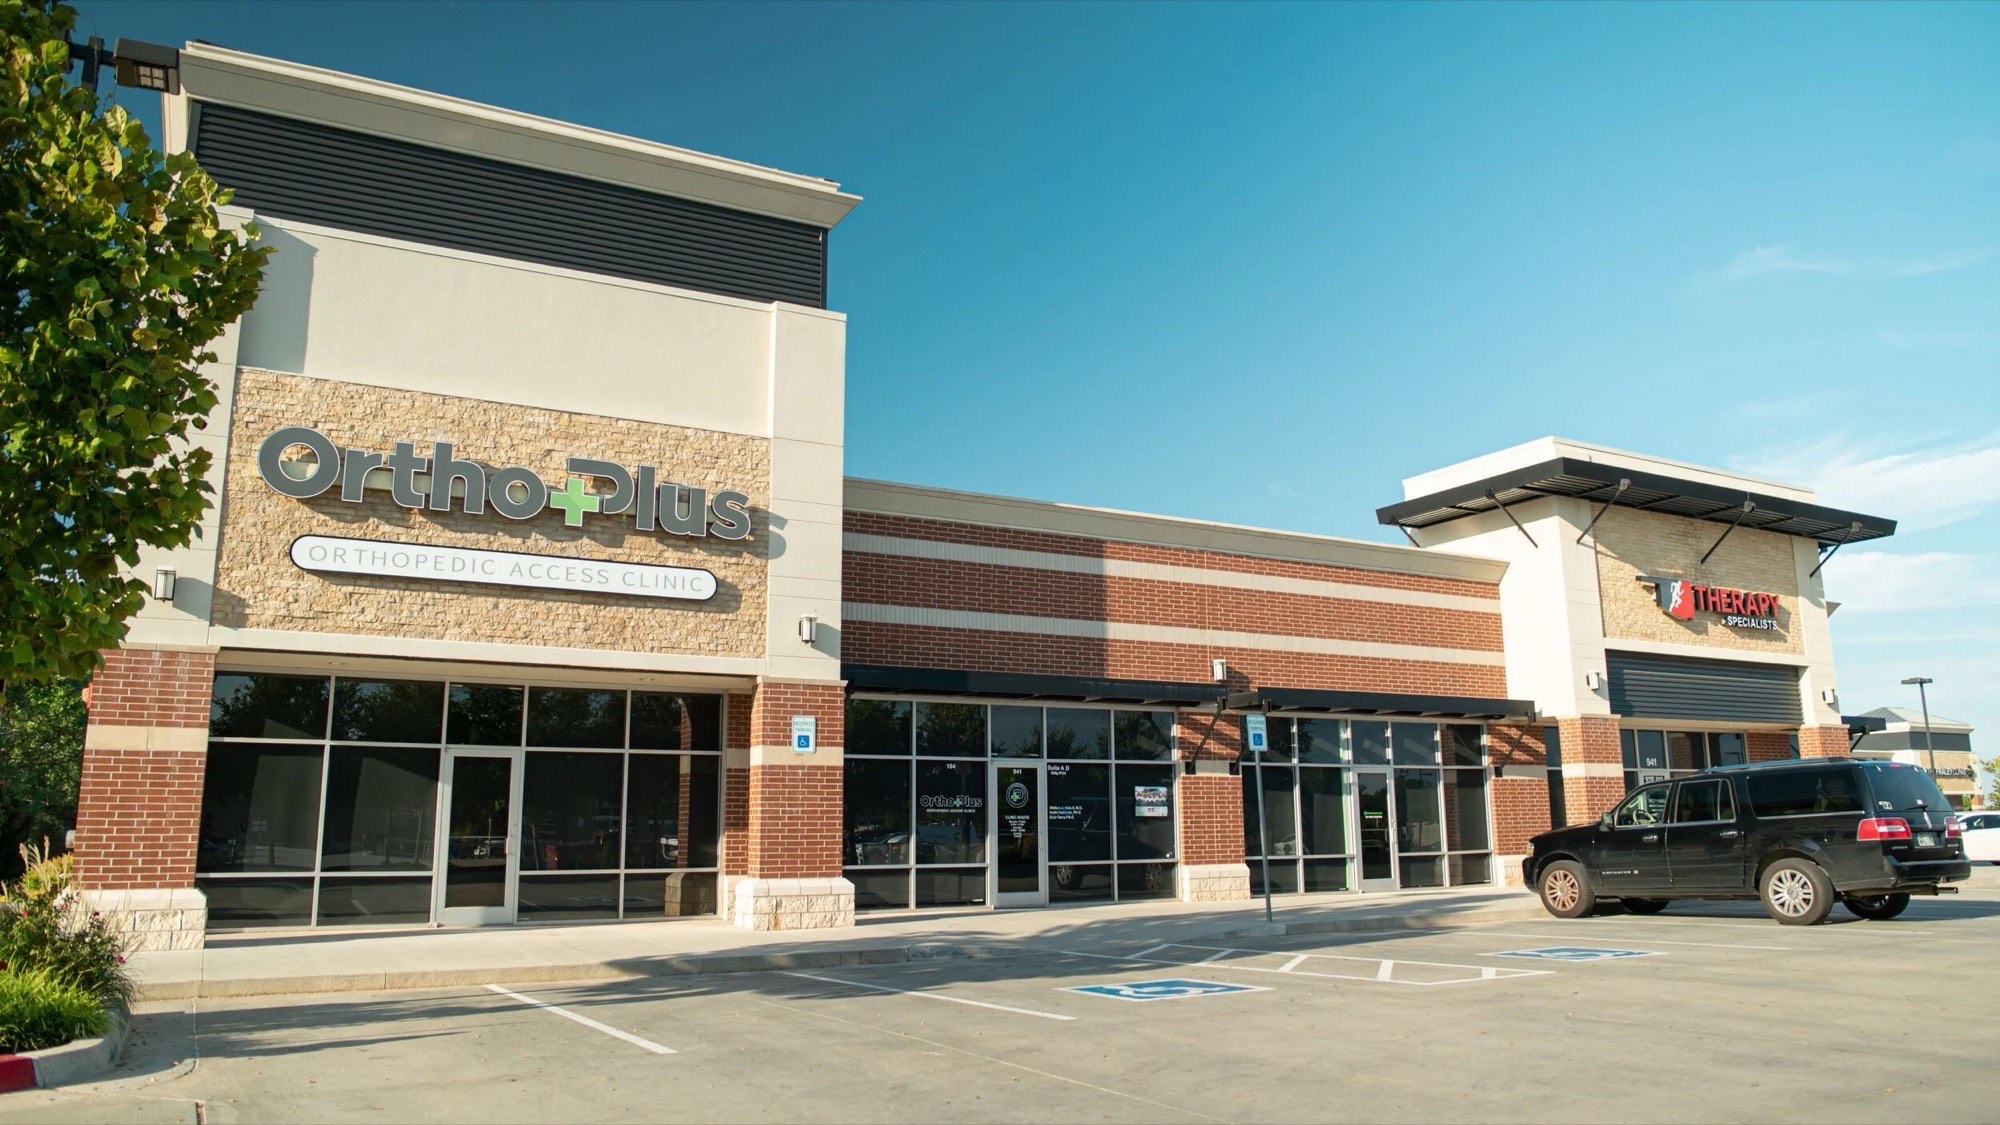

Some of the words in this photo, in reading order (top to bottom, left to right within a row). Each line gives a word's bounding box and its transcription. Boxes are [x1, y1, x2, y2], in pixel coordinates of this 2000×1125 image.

[308, 544, 496, 577] ORTHOPEDIC
[509, 561, 610, 586] ACCESS
[621, 571, 703, 593] CLINIC
[1692, 584, 1780, 618] THERAPY
[1727, 615, 1778, 631] SPECIALISTS
[1645, 757, 1657, 767] 941
